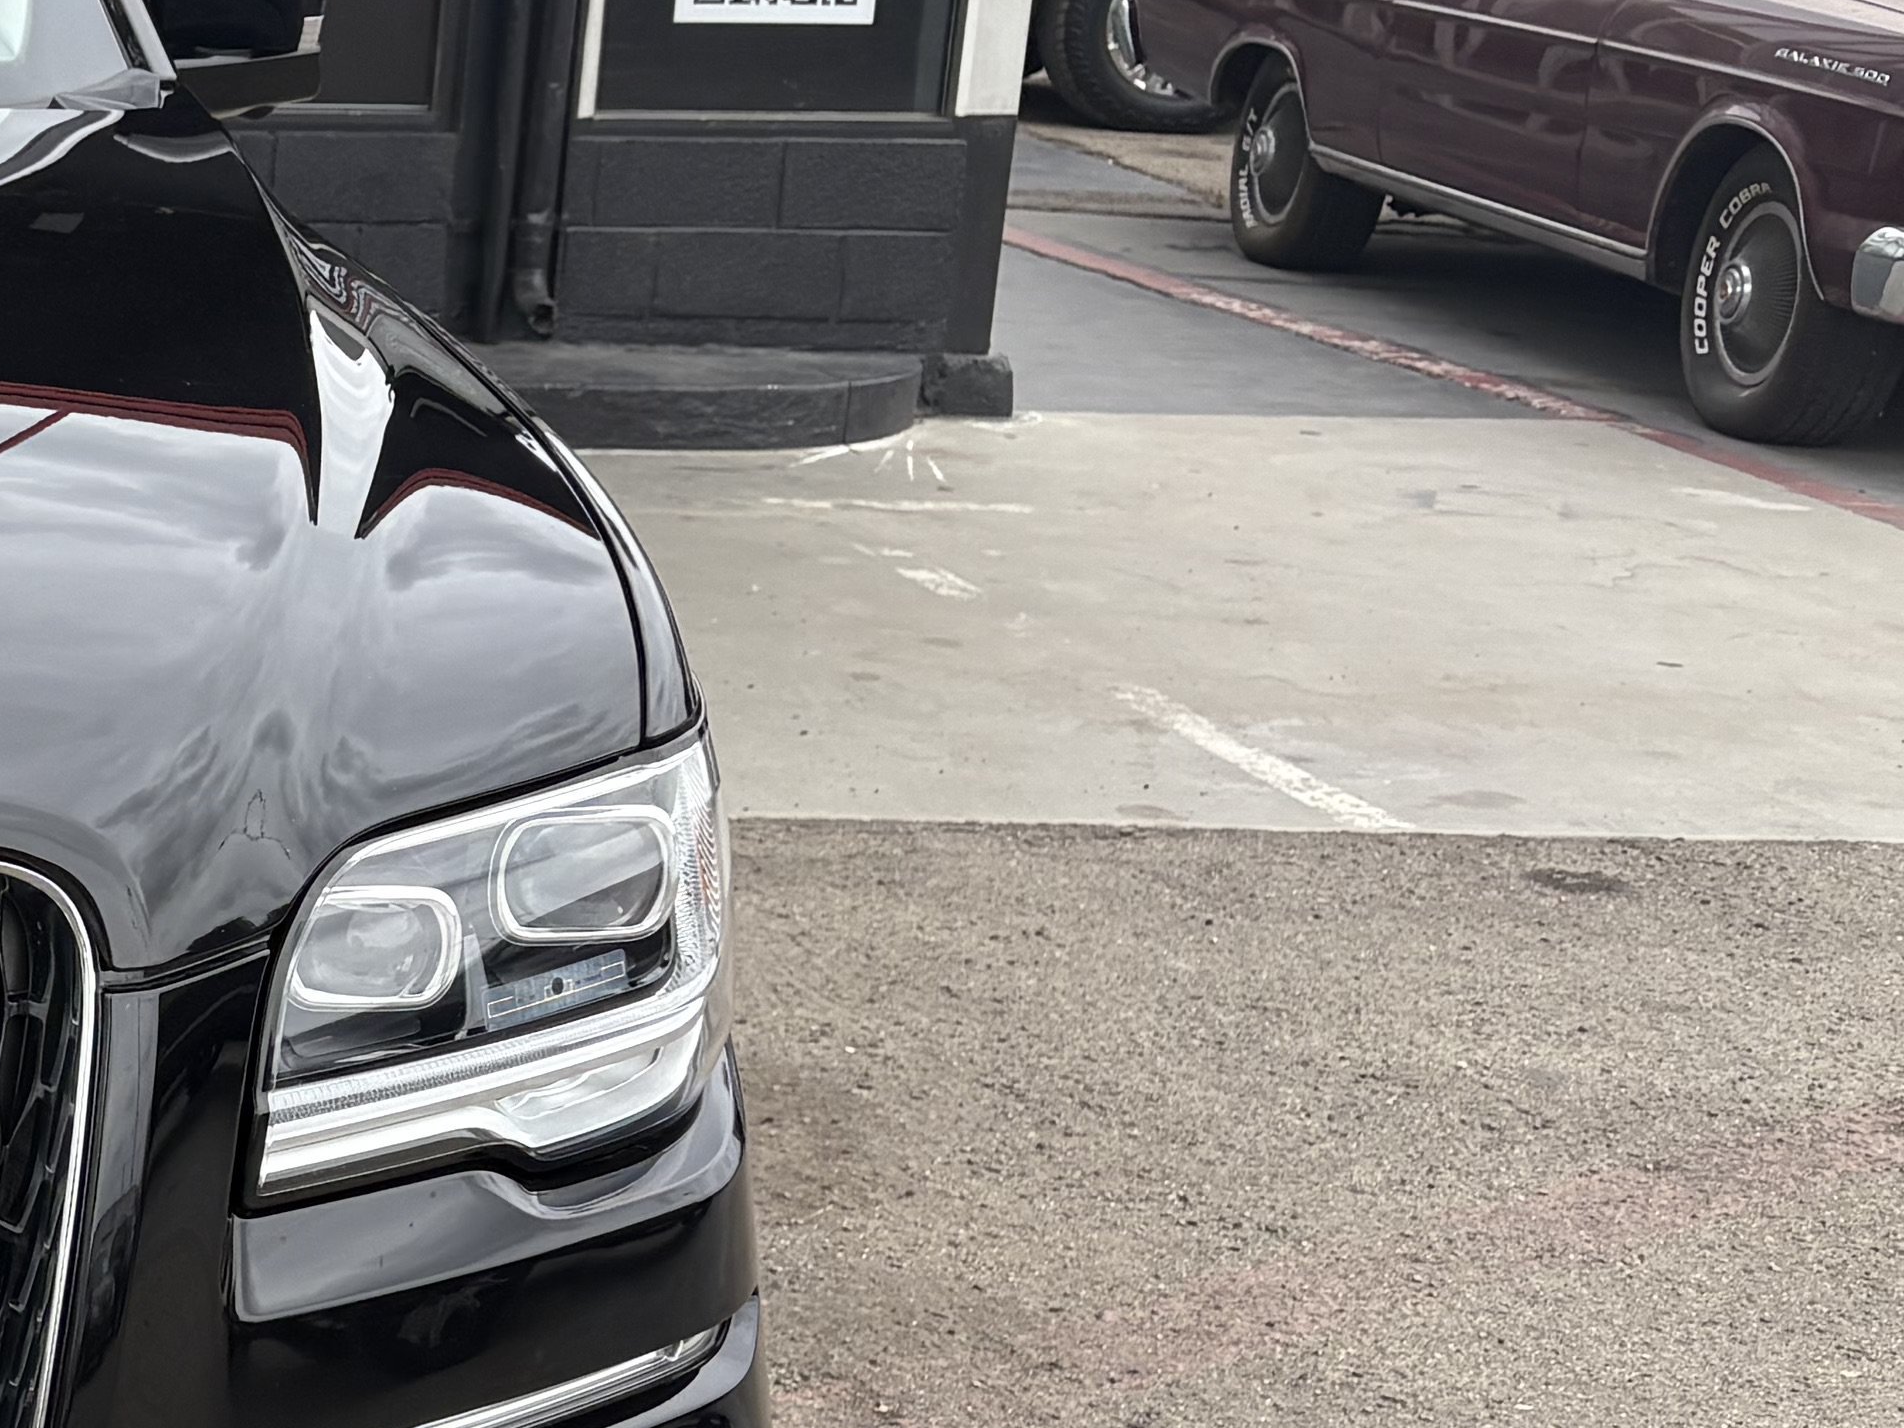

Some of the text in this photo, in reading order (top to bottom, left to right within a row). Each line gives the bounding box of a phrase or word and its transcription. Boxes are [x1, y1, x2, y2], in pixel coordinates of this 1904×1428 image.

[1238, 163, 1259, 229] RADIAL
[1693, 182, 1773, 355] COOPER COBRA
